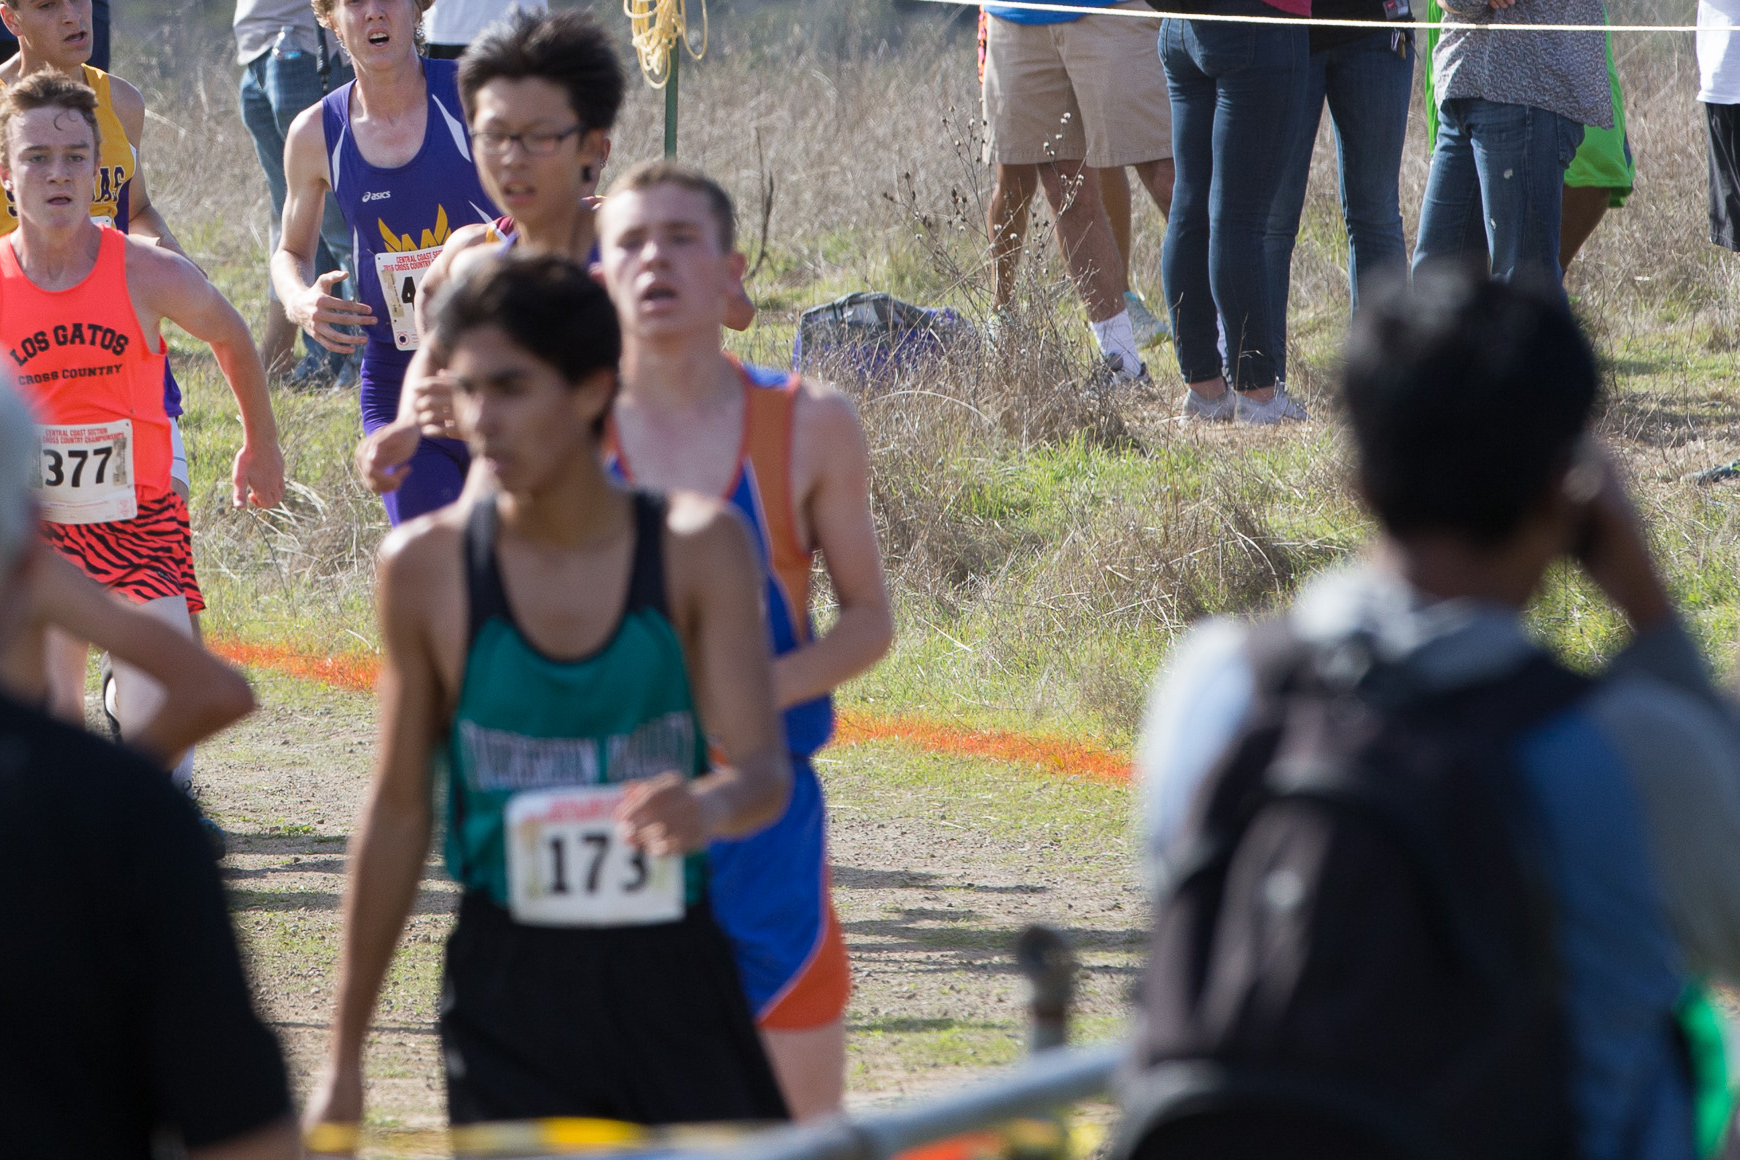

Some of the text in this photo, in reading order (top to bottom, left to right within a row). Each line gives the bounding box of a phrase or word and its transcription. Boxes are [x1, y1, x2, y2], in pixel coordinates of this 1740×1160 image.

[370, 191, 391, 201] asics
[395, 263, 410, 272] CROSS
[396, 255, 417, 264] CENTRAL
[417, 252, 432, 262] COAST
[10, 323, 129, 367] LOS GATOS
[18, 364, 123, 386] CROSS COUNTRY
[43, 446, 113, 488] 377
[549, 834, 649, 896] 173
